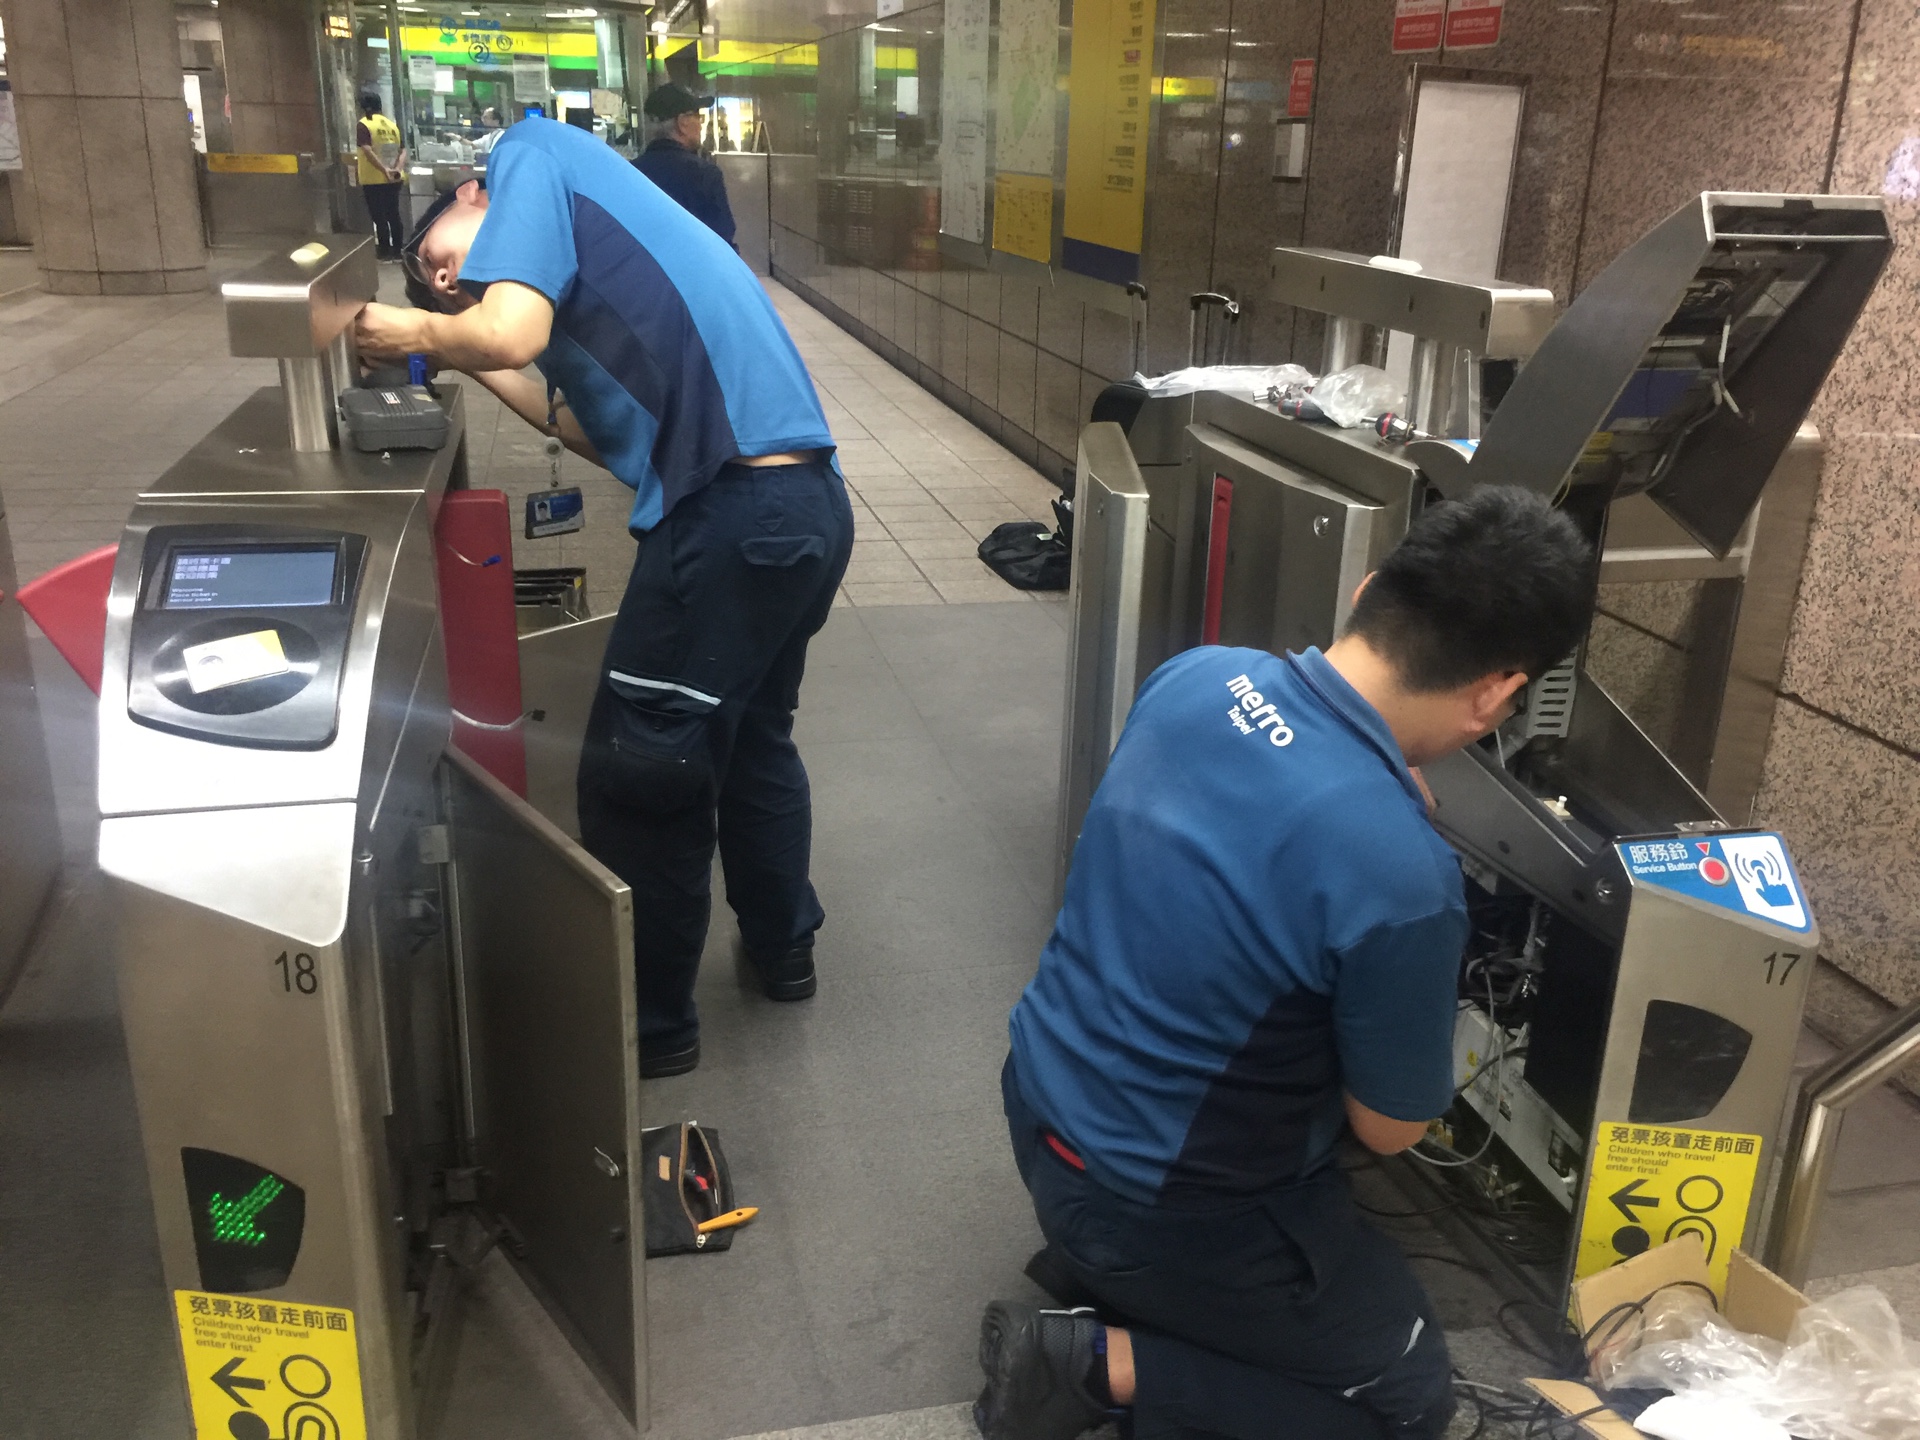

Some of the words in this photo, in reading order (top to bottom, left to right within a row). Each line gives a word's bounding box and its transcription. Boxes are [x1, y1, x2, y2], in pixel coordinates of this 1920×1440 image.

[1226, 674, 1293, 746] metro
[1227, 705, 1256, 735] Taipei
[1629, 842, 1688, 864] 服務鈴
[1632, 864, 1666, 874] Service
[1668, 861, 1697, 872] Button
[275, 951, 317, 994] 18
[1764, 951, 1801, 985] 17
[1610, 1126, 1755, 1155] 免票孩童走前面
[1607, 1154, 1628, 1163] free
[1631, 1157, 1668, 1167] should
[1608, 1144, 1654, 1156] Children
[1658, 1150, 1681, 1159] who
[1684, 1152, 1715, 1162] travel
[1605, 1163, 1634, 1172] enter
[1637, 1165, 1661, 1175] first.
[189, 1295, 347, 1332] 免票孩童走前面
[193, 1317, 243, 1331] Children
[246, 1325, 272, 1335] who
[275, 1328, 310, 1339] travel
[194, 1327, 217, 1338] free
[221, 1331, 261, 1343] should
[196, 1339, 226, 1348] enter
[230, 1341, 257, 1352] first.
